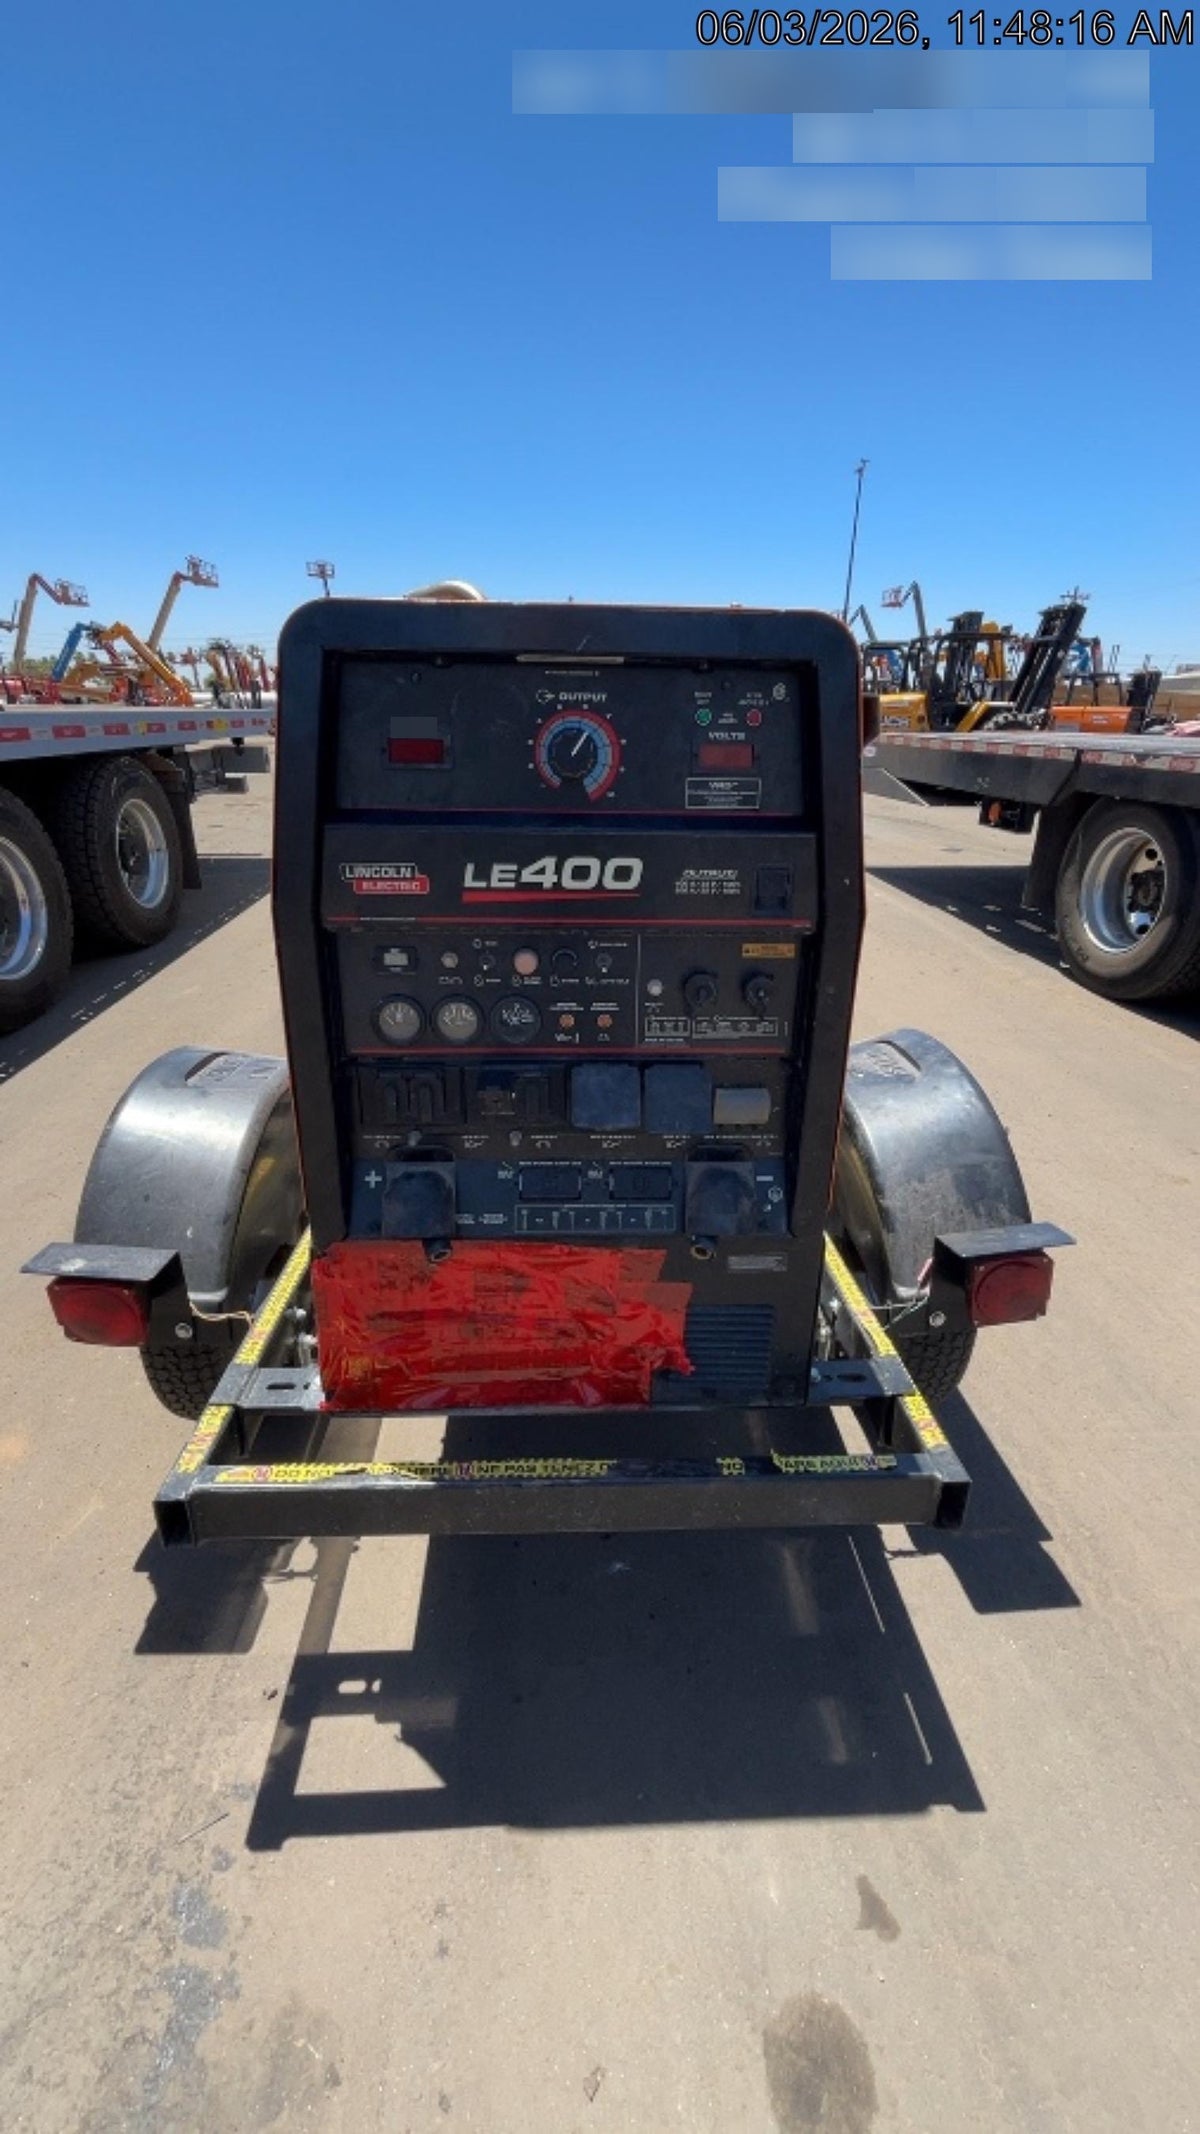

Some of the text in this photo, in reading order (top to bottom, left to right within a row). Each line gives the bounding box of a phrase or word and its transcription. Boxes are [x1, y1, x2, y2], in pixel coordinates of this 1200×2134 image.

[558, 692, 608, 702] OUTPUT
[344, 865, 411, 878] LINCOLN
[463, 855, 642, 890] LE400
[361, 880, 421, 891] ELECTRIC
